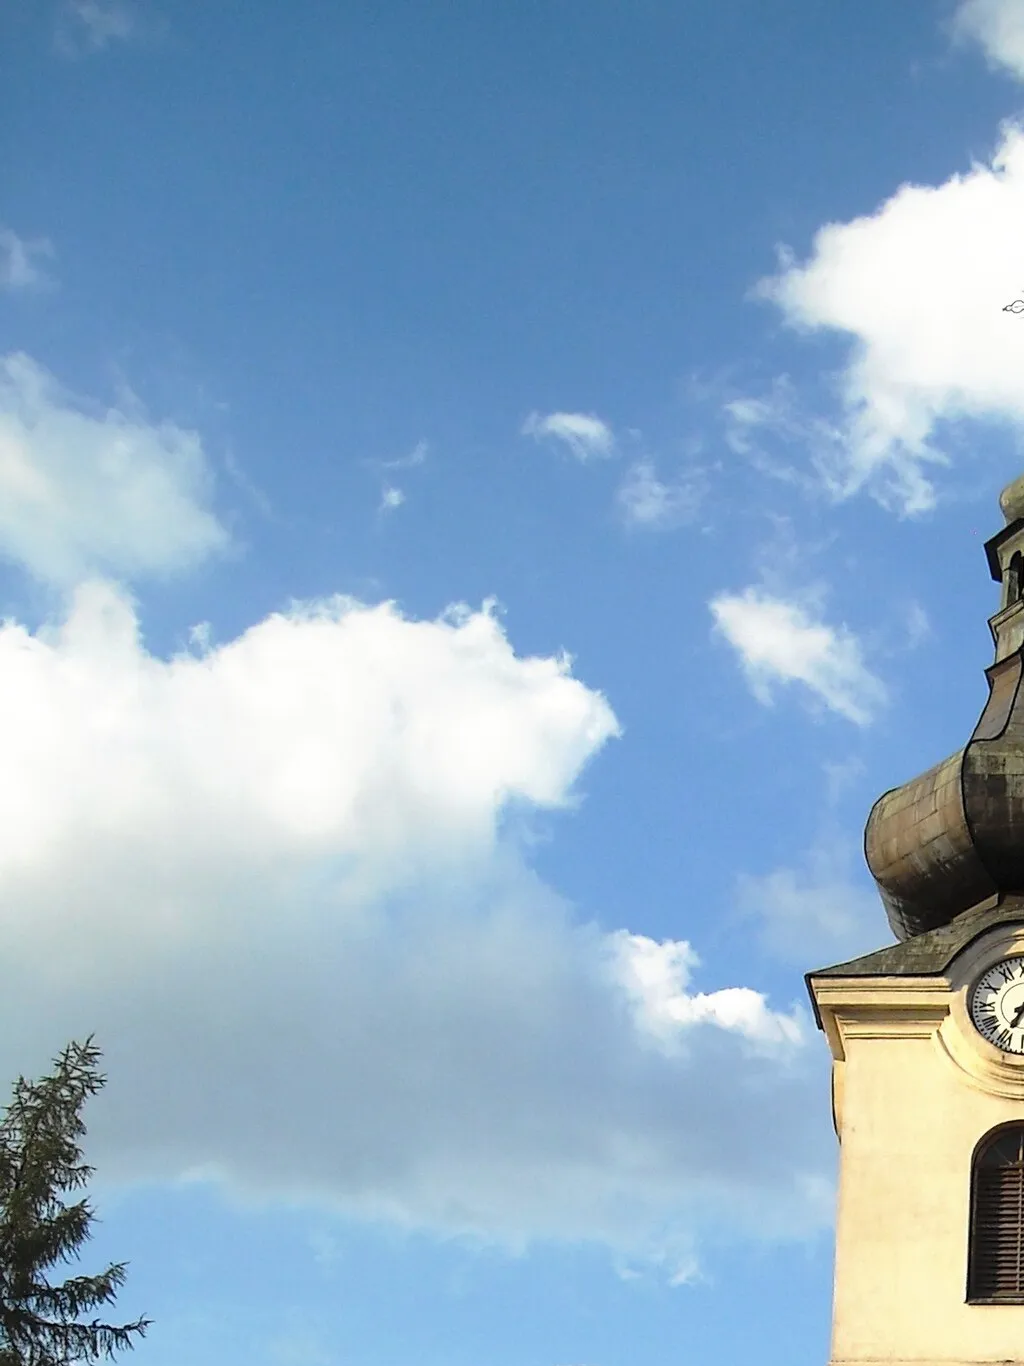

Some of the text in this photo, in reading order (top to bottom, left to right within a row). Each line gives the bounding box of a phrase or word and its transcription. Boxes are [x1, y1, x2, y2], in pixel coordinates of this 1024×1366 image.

[1000, 966, 1015, 984] XI
[984, 982, 1001, 995] X
[979, 1001, 996, 1013] IX
[981, 1015, 1002, 1035] VIII
[997, 1028, 1014, 1047] VII
